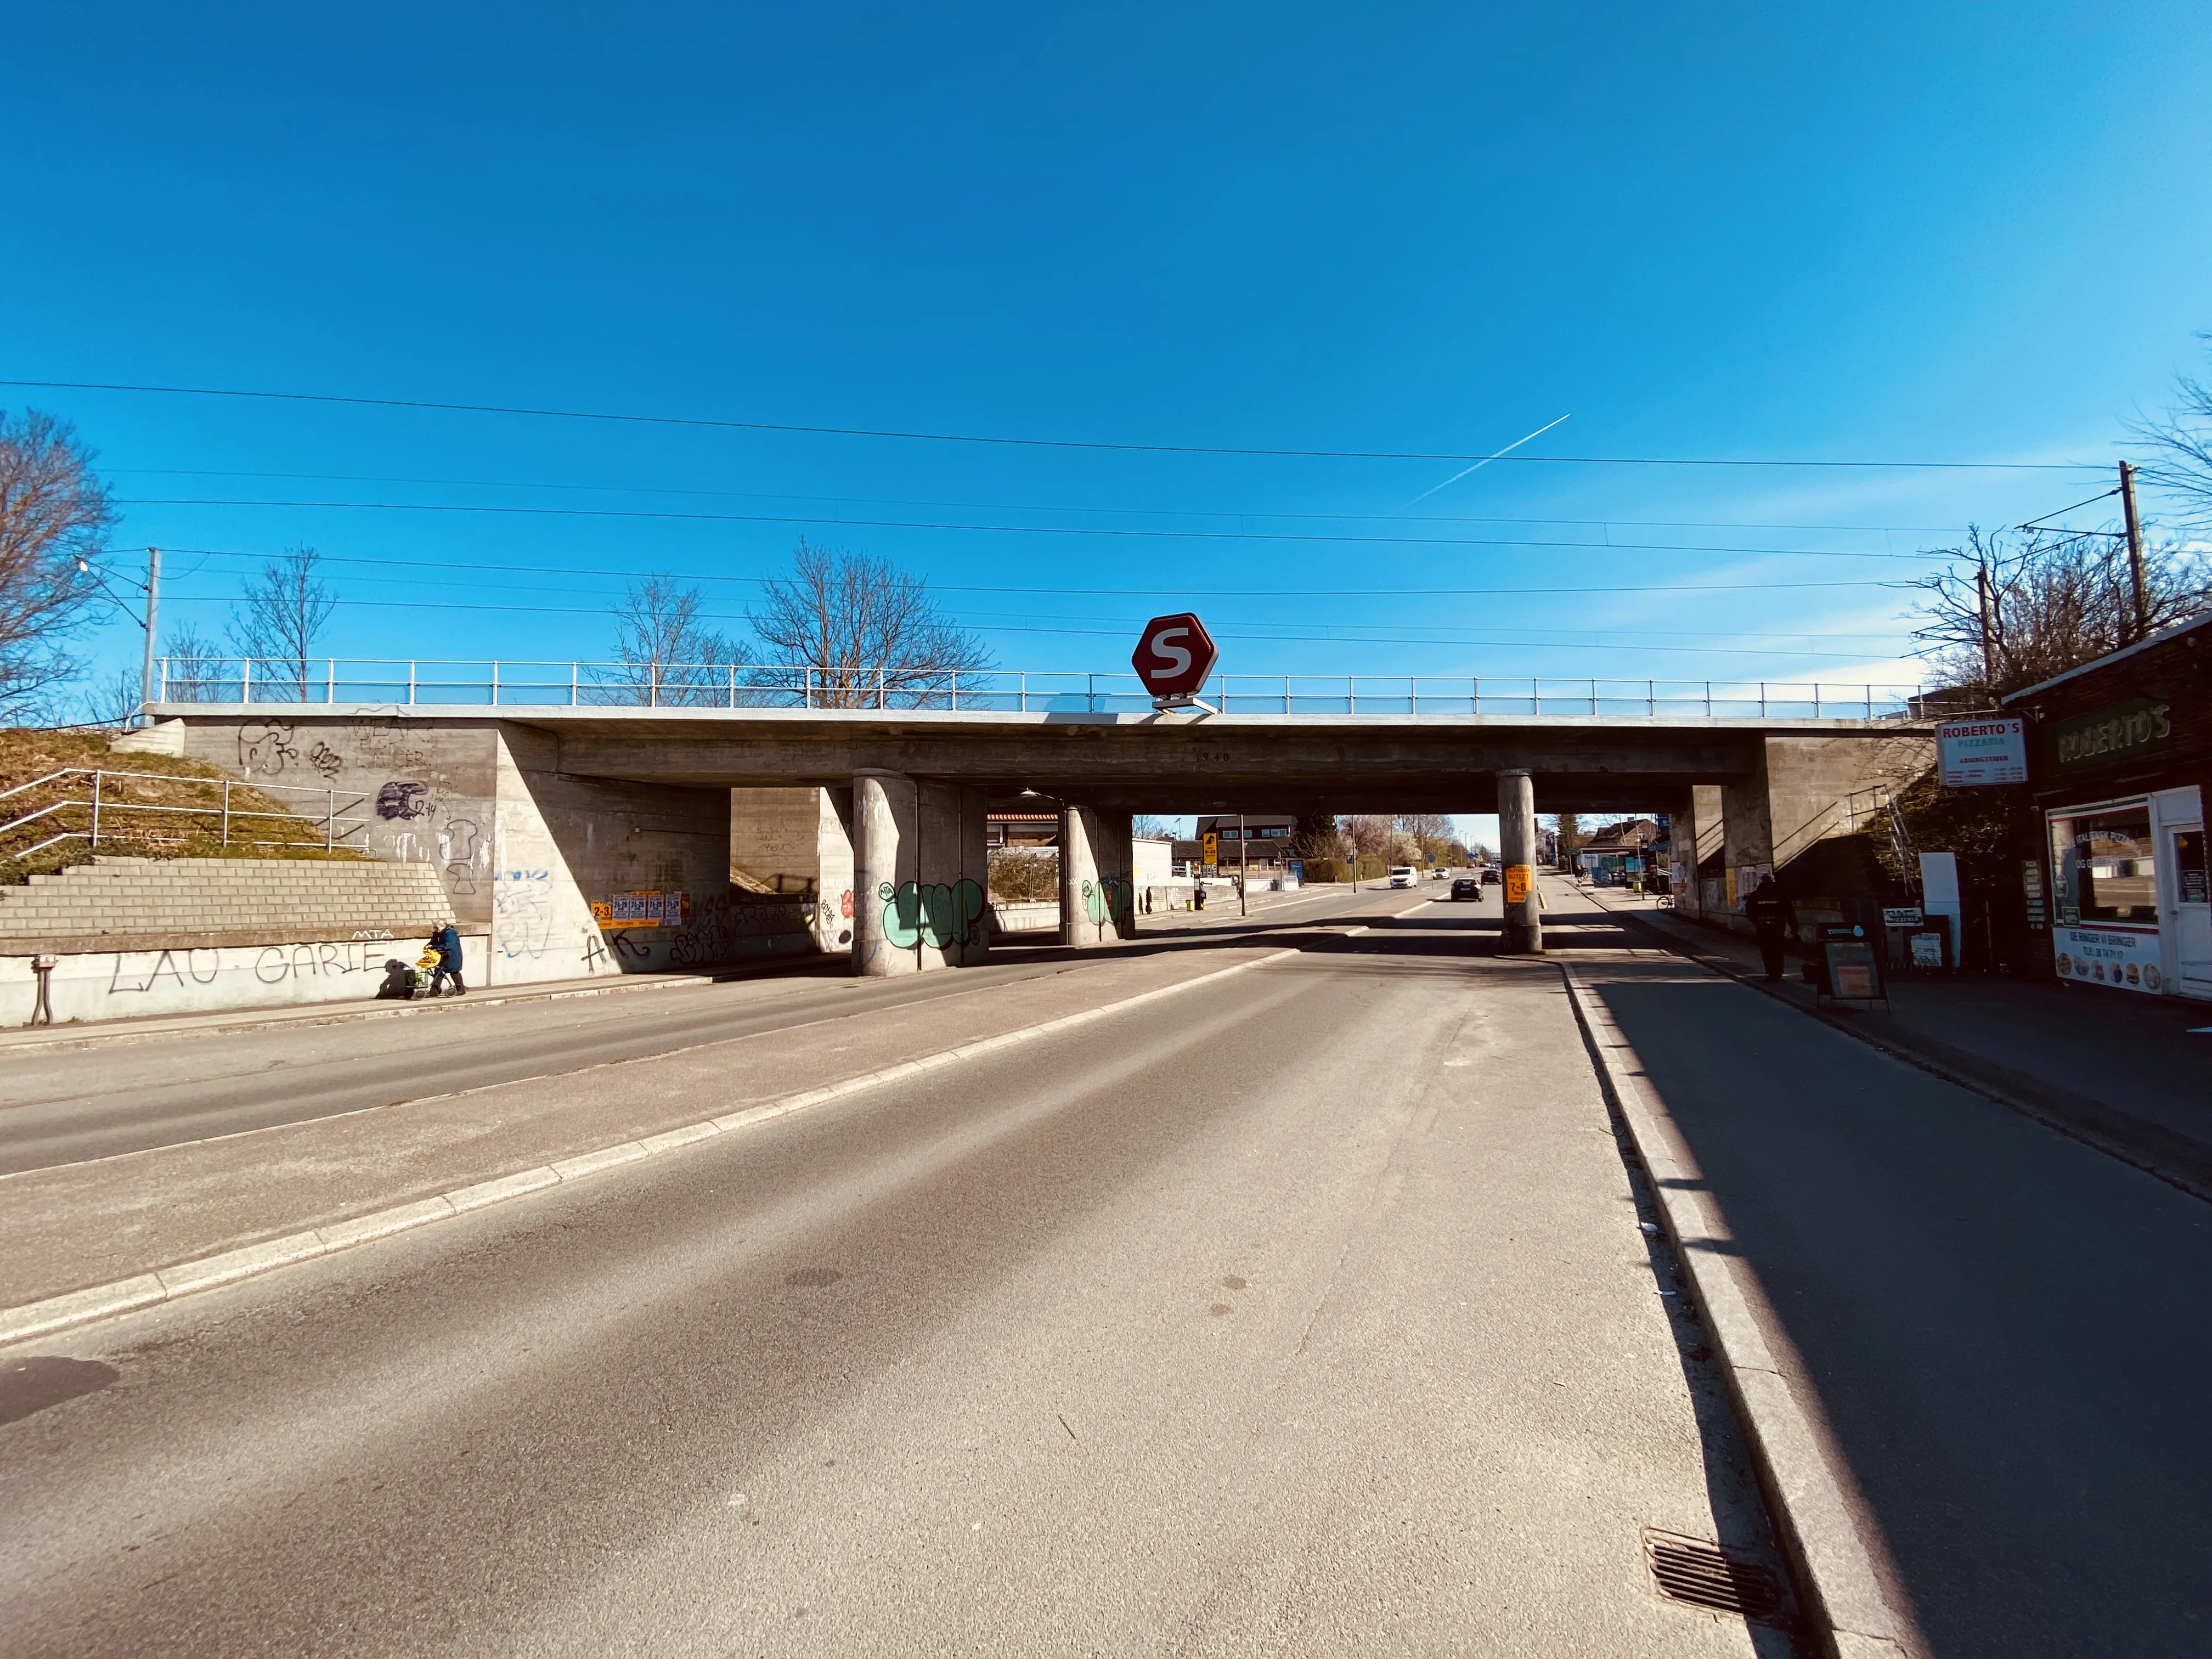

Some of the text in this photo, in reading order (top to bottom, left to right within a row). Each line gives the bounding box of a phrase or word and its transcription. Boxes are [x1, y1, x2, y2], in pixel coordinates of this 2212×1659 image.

[1151, 628, 1191, 678] S
[1510, 883, 1526, 891] 7-8
[352, 930, 394, 939] MTA
